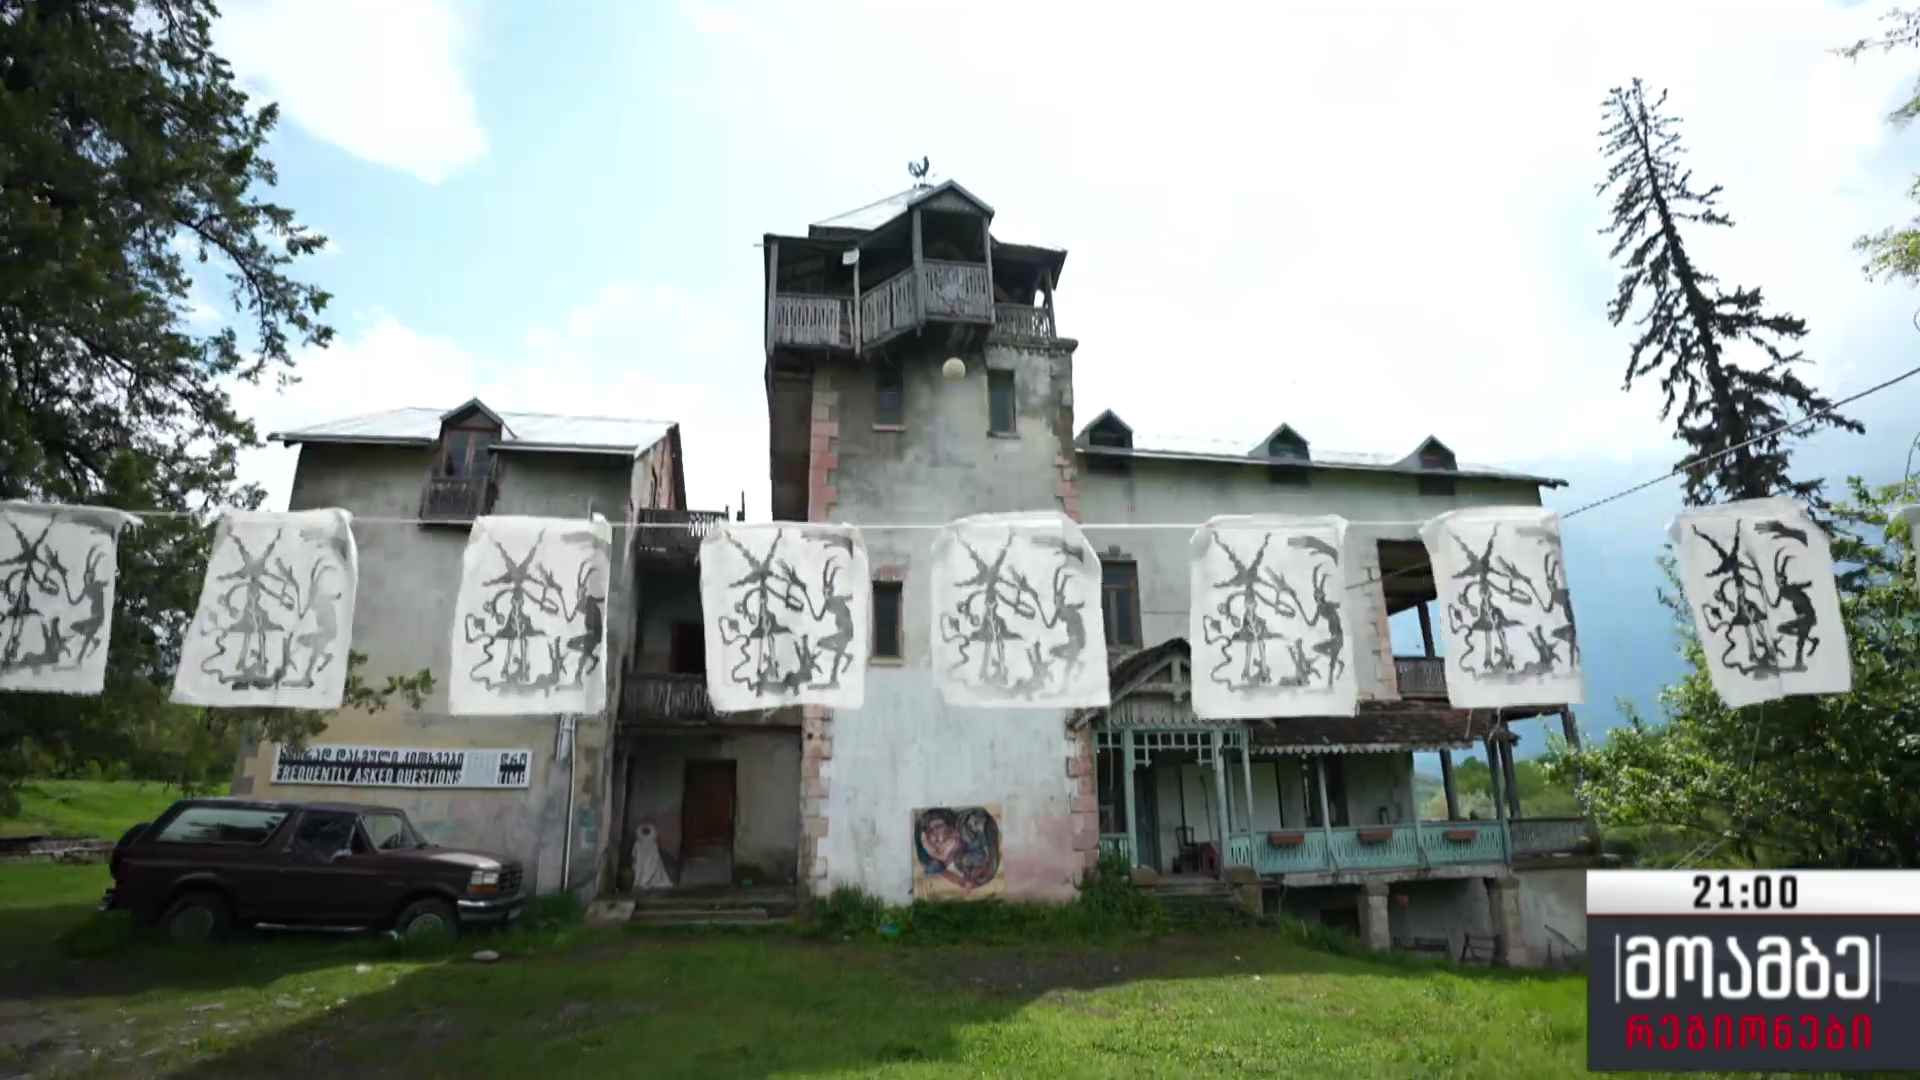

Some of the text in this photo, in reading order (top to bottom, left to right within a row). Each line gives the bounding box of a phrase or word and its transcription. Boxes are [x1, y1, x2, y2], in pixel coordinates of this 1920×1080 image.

[278, 764, 351, 783] FREQUENTLY
[353, 768, 393, 784] ASKED
[395, 768, 463, 784] QUESTIONS
